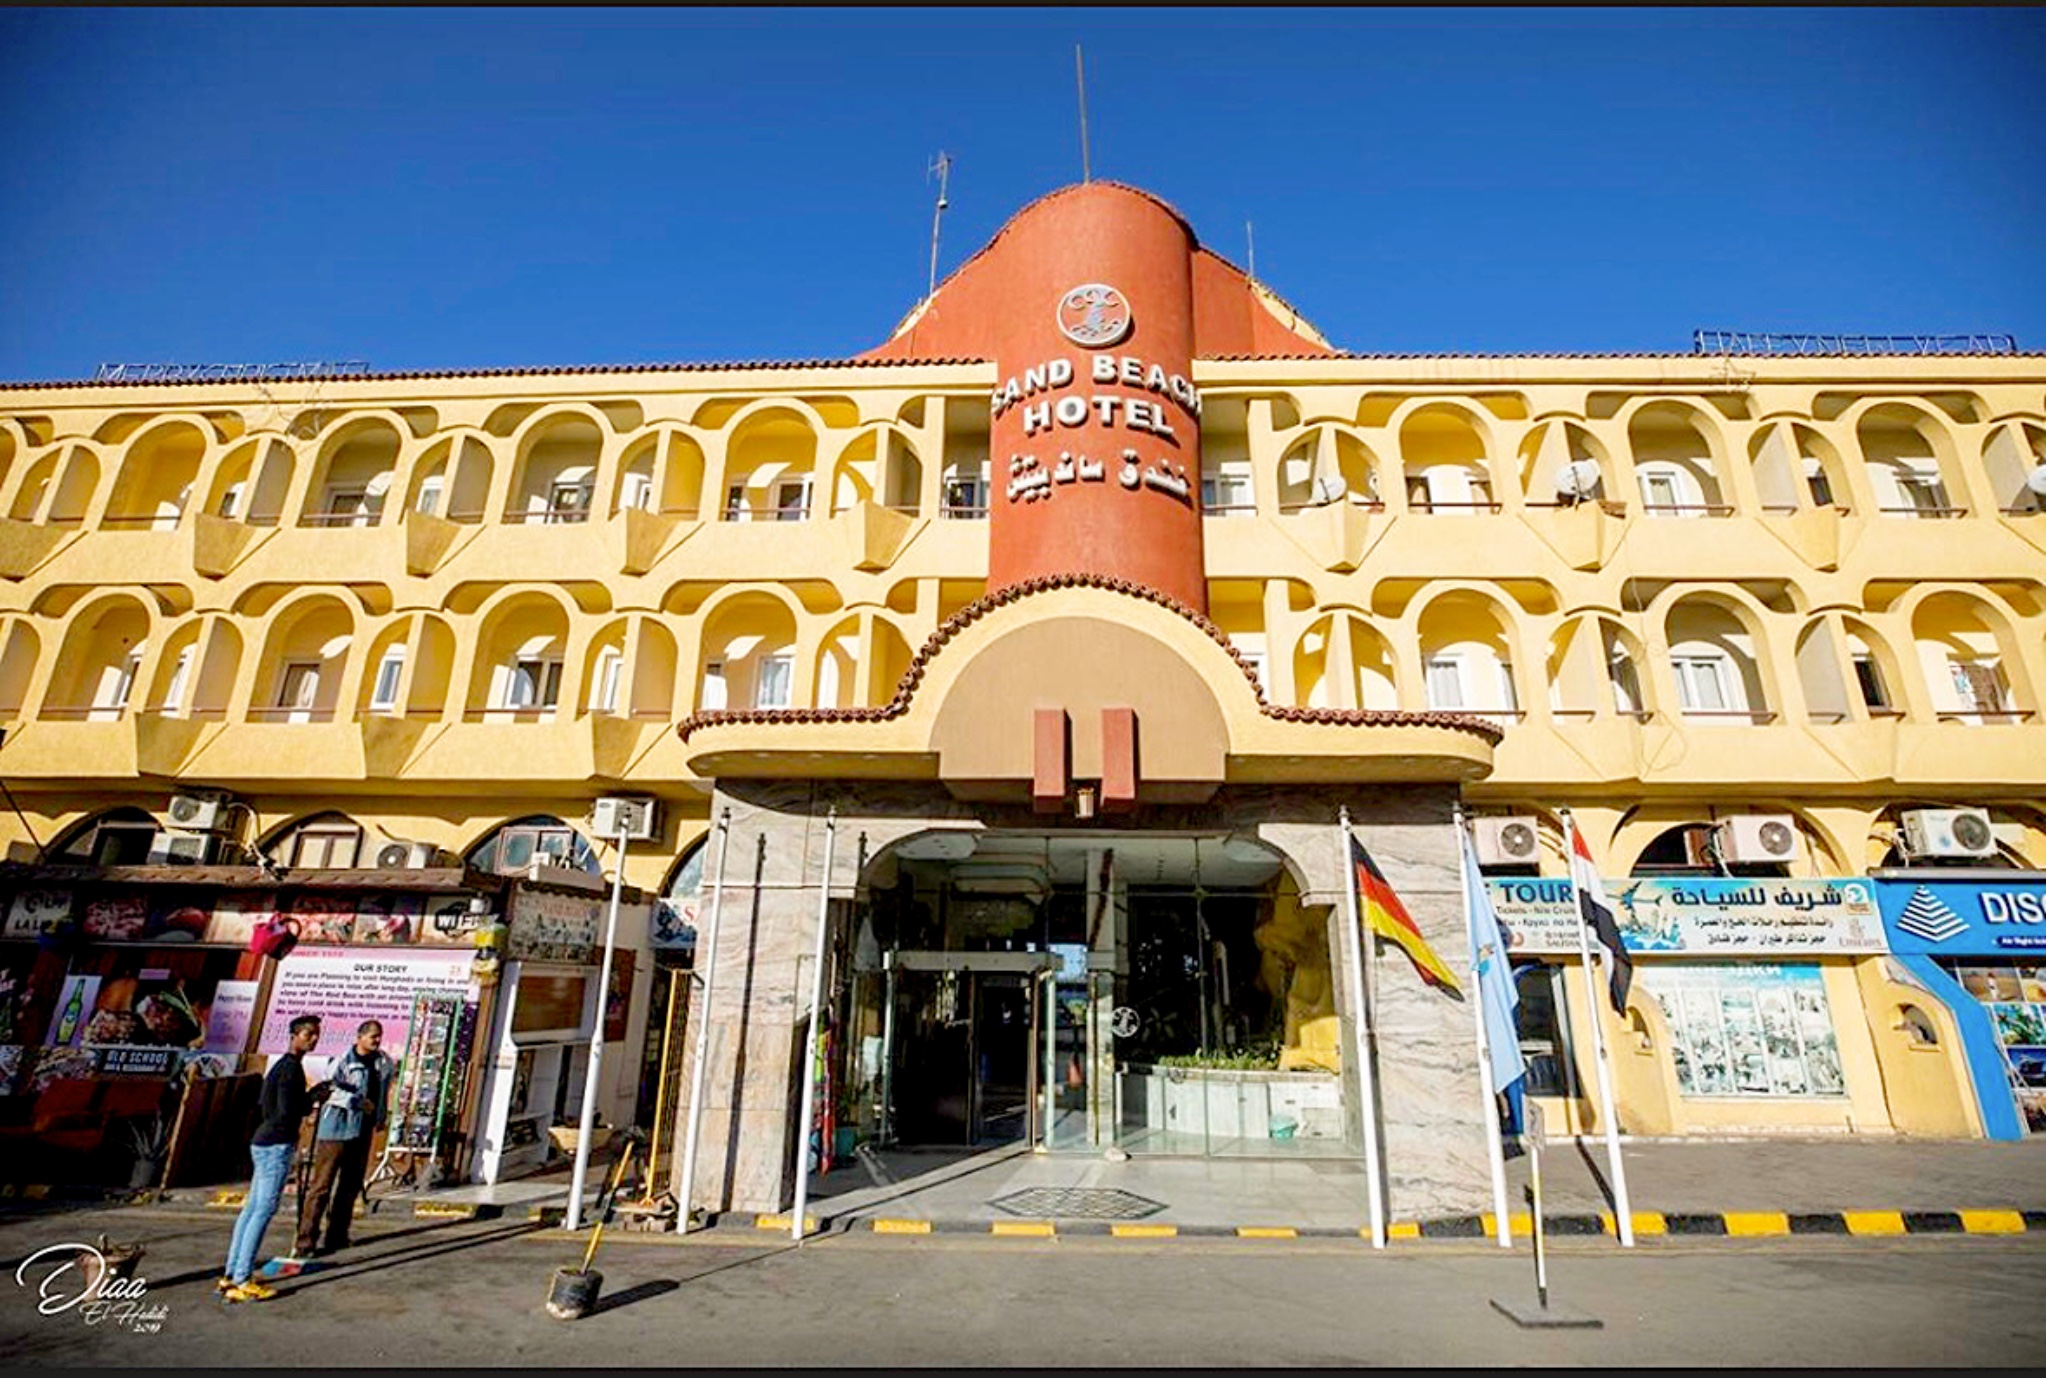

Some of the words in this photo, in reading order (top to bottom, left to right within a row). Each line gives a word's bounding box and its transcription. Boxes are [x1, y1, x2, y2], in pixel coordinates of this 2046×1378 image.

[991, 358, 1072, 415] SAND
[1092, 355, 1202, 413] BEACH
[1023, 395, 1174, 436] HOTEL
[1118, 448, 1188, 496] فندق
[1553, 906, 1577, 914] Cruis
[1671, 886, 1767, 911] للسياحة
[1773, 883, 1843, 912] شريف
[1978, 892, 2046, 924] DIS
[354, 963, 374, 972] OUR
[376, 964, 408, 973] STORY
[107, 1050, 127, 1063] OLD
[129, 1051, 168, 1065] SCHOOL
